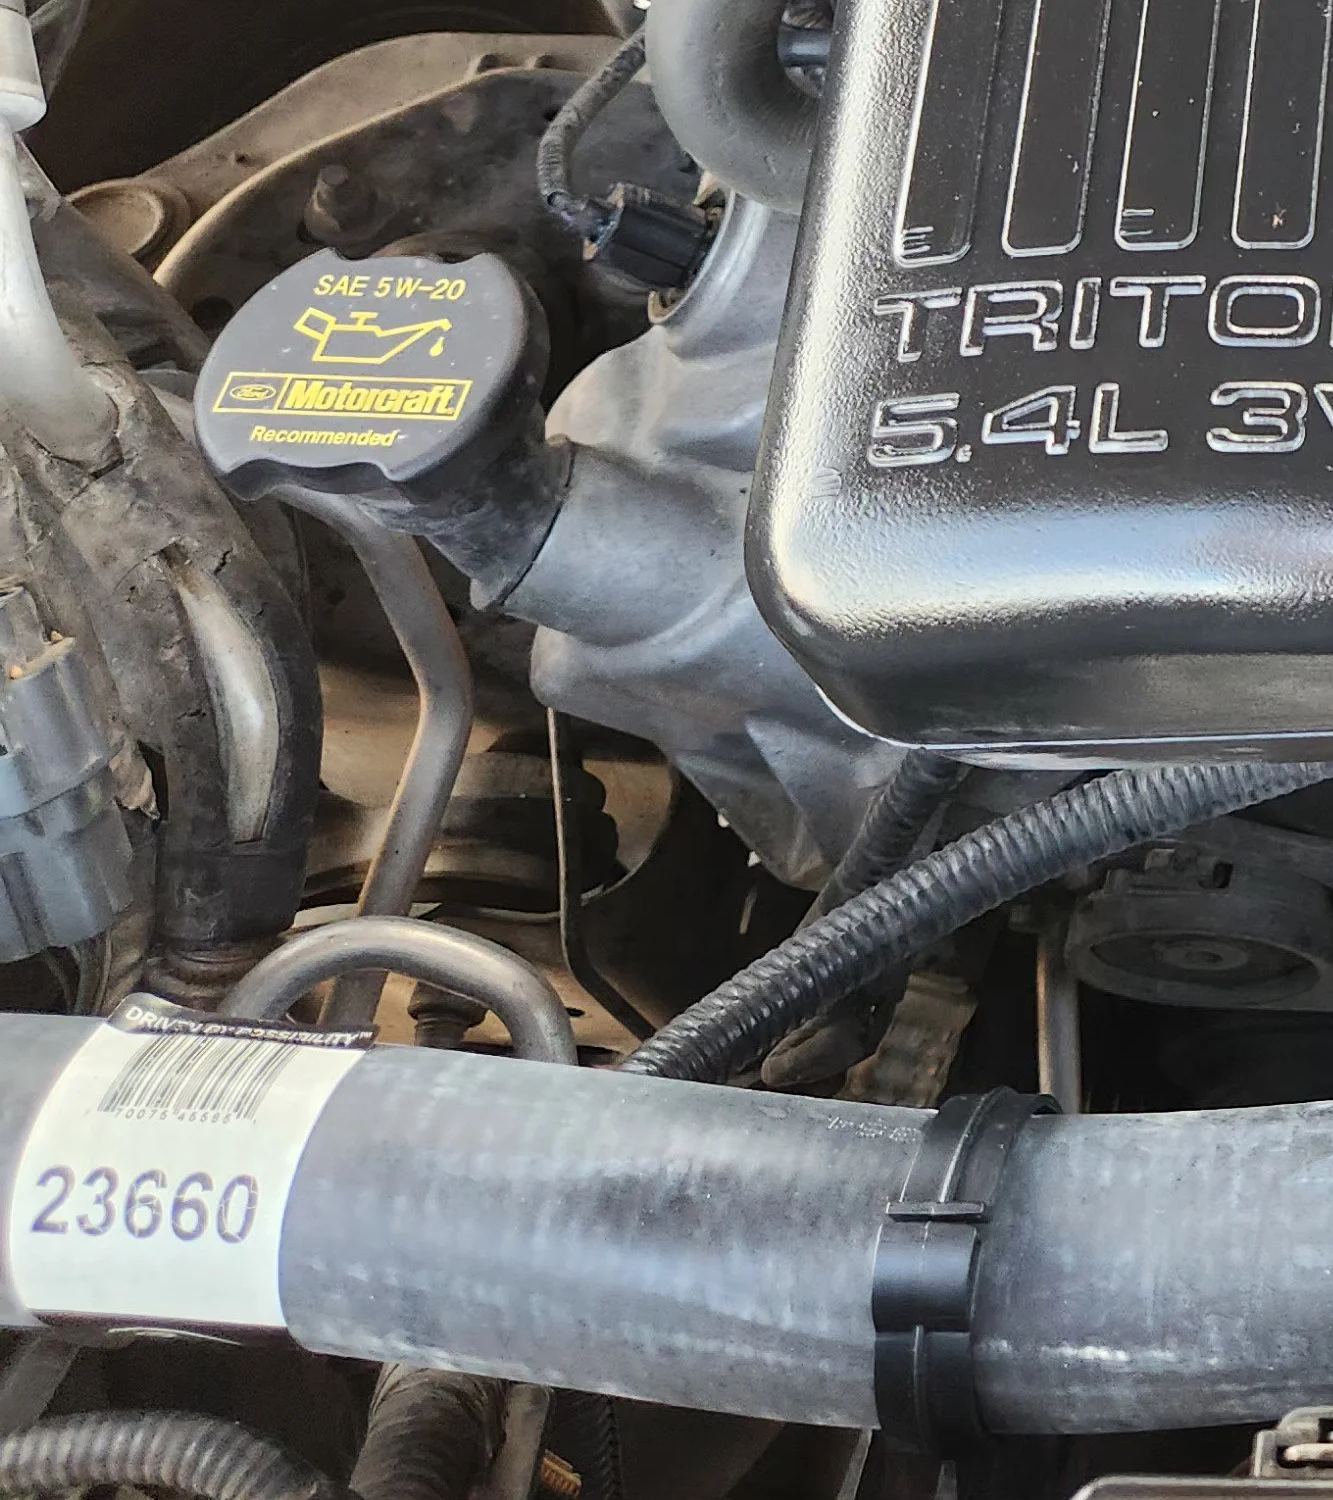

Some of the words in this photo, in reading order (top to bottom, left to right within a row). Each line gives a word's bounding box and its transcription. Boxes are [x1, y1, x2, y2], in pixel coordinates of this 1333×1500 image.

[313, 274, 370, 297] SAE
[374, 276, 467, 301] 5W-20
[283, 379, 456, 416] Motorcraft
[249, 424, 398, 447] Recommended
[866, 381, 1170, 469] 5.4L
[30, 1163, 260, 1245] 23660
